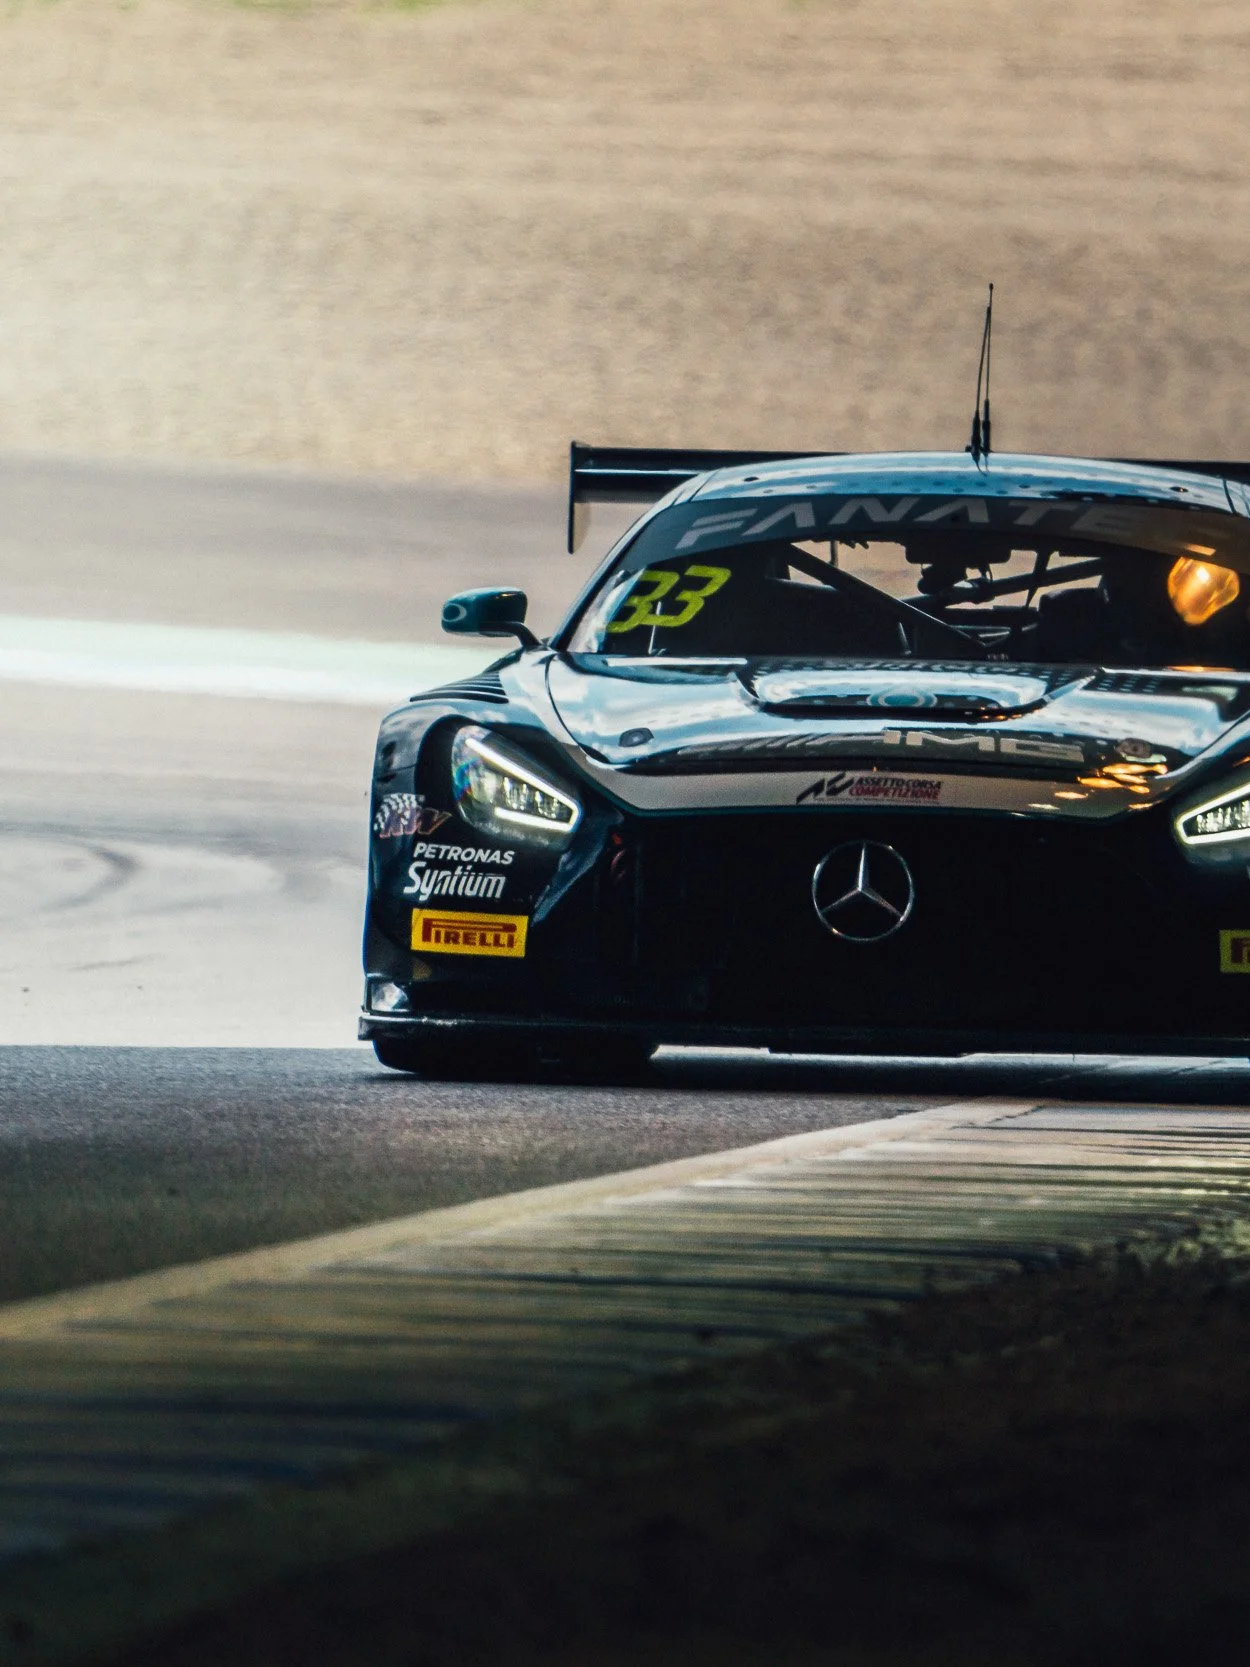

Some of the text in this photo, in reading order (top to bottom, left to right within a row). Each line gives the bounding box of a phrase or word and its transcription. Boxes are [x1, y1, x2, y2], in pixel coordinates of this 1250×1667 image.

[606, 565, 732, 633] 33
[849, 785, 941, 799] COMPETIZIONE
[906, 778, 943, 789] CORSA
[413, 842, 516, 865] PETRONAS
[403, 861, 507, 901] Syntium
[421, 917, 518, 949] PIRELLI
